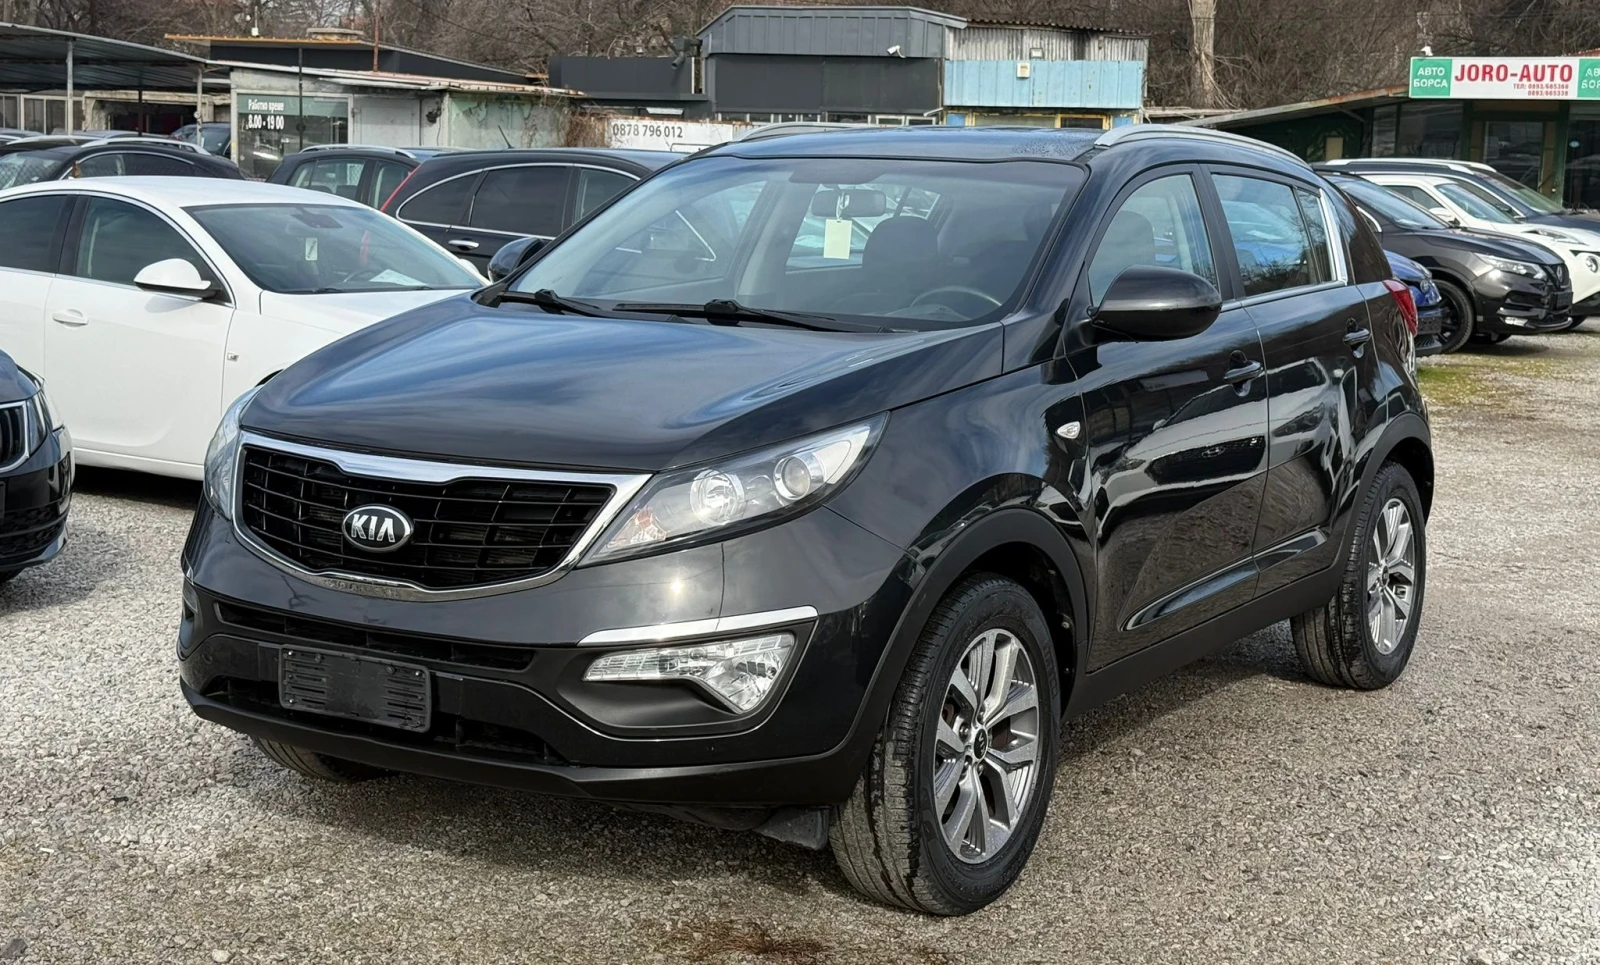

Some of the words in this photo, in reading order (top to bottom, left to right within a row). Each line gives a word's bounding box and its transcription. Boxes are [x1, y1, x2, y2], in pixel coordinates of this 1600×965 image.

[1417, 67, 1445, 76] АВТО
[1454, 64, 1573, 83] JORO-AUTO
[1413, 79, 1448, 88] БОРСА
[612, 123, 640, 137] 0878
[642, 124, 662, 137] 796
[663, 125, 683, 139] 012
[351, 513, 396, 543] KIA
